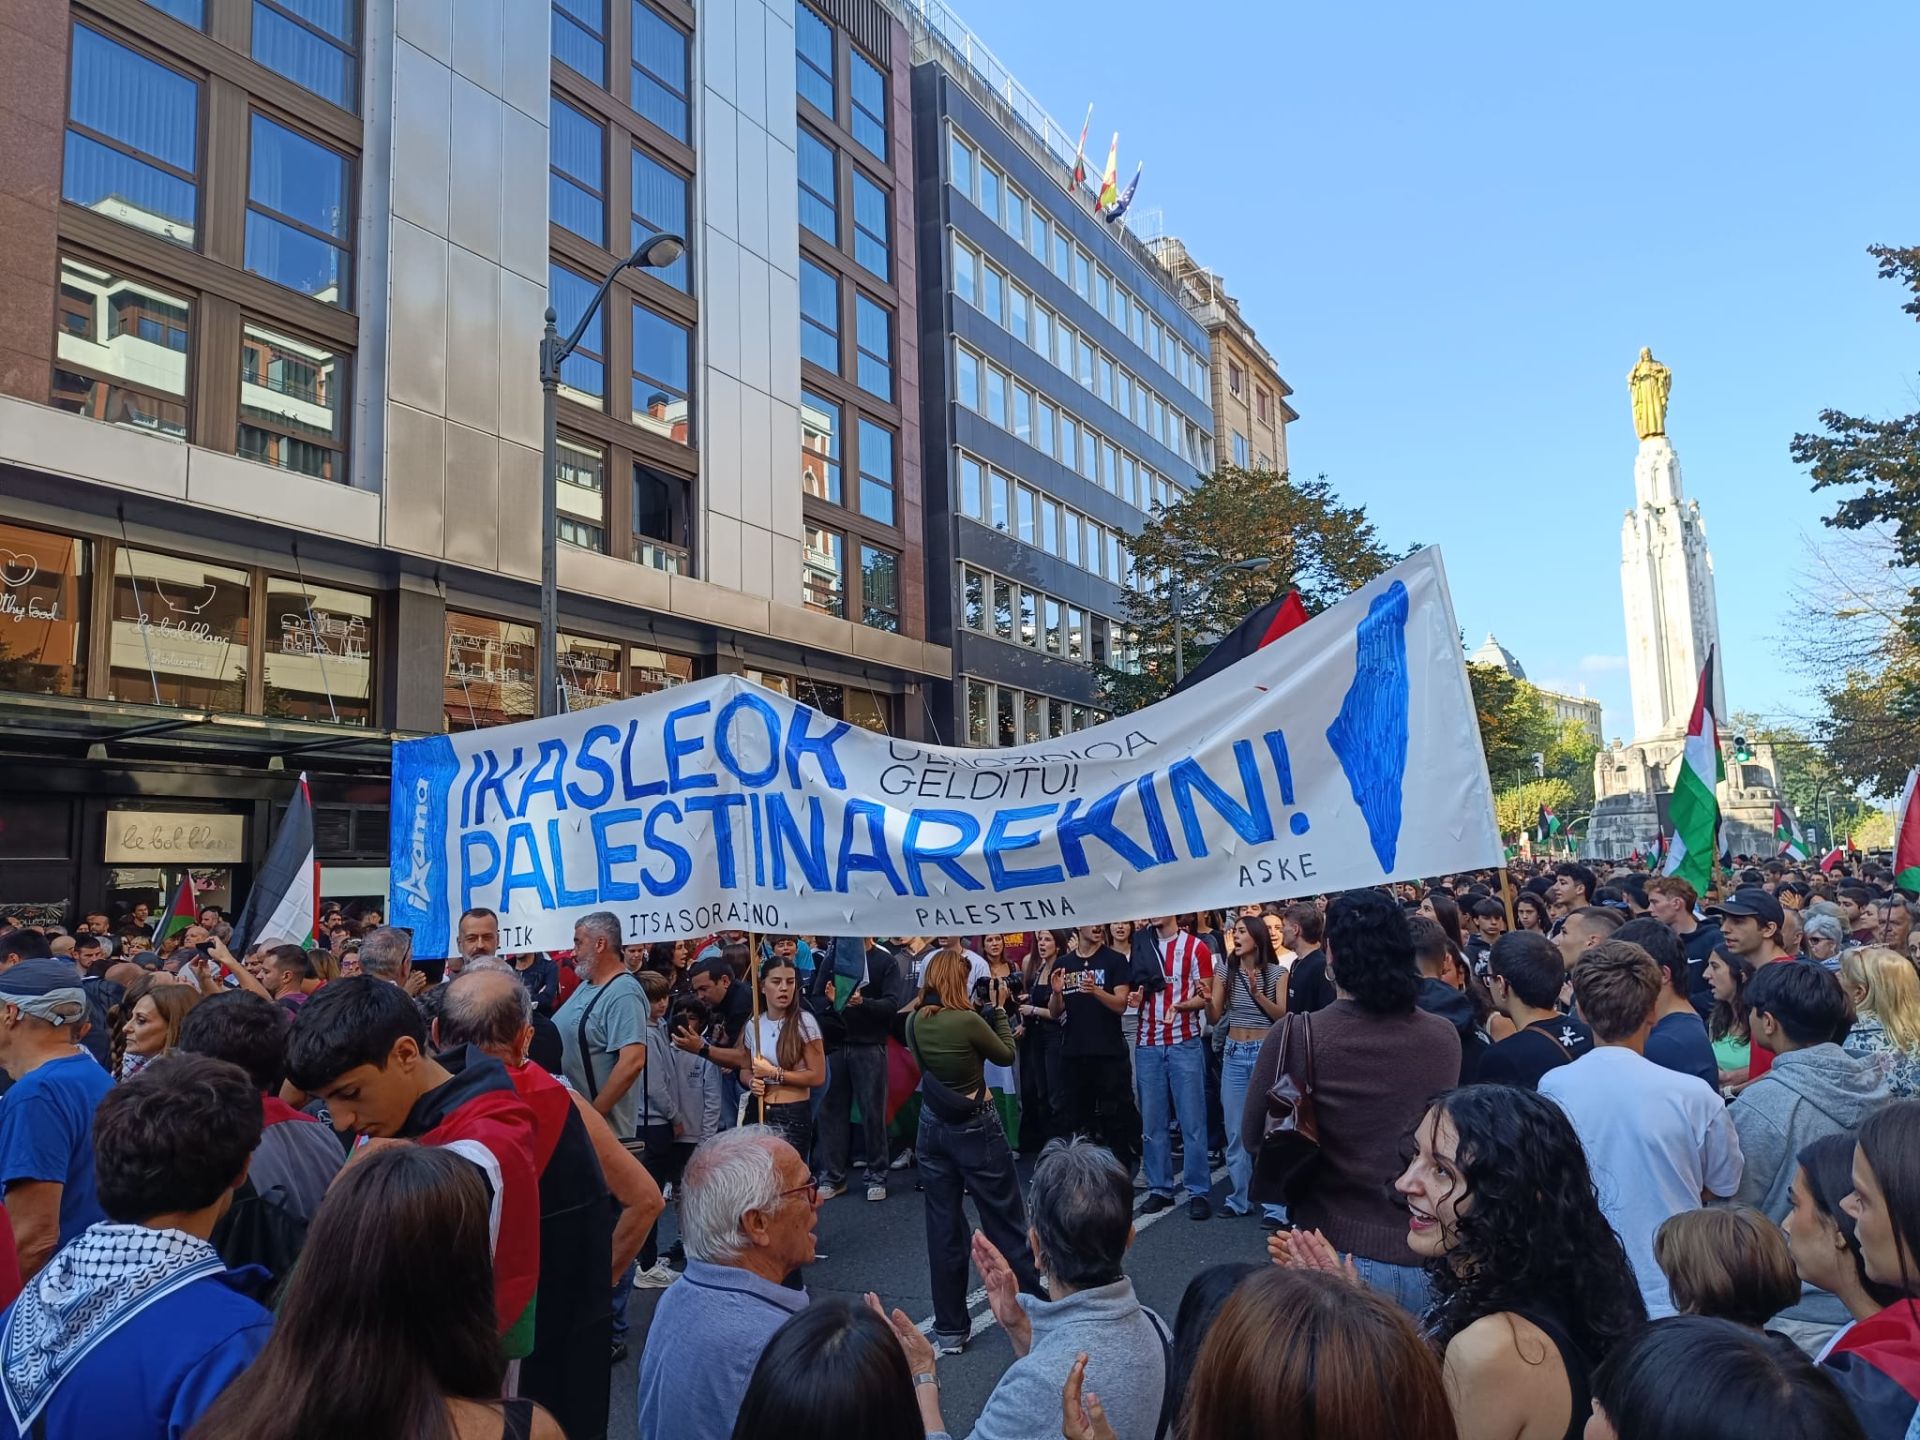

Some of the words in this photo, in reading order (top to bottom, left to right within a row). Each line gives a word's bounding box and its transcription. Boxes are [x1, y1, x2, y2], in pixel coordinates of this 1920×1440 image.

[460, 691, 851, 828] IKASLEOK
[879, 764, 1079, 801] GELDITU!
[121, 824, 145, 850] le
[149, 825, 183, 850] bol
[460, 725, 1311, 912] PALESTINAREKIN!
[629, 902, 789, 938] ITSASORAINO.
[915, 896, 1076, 928] PALESTINA
[1238, 852, 1318, 888] ASKE
